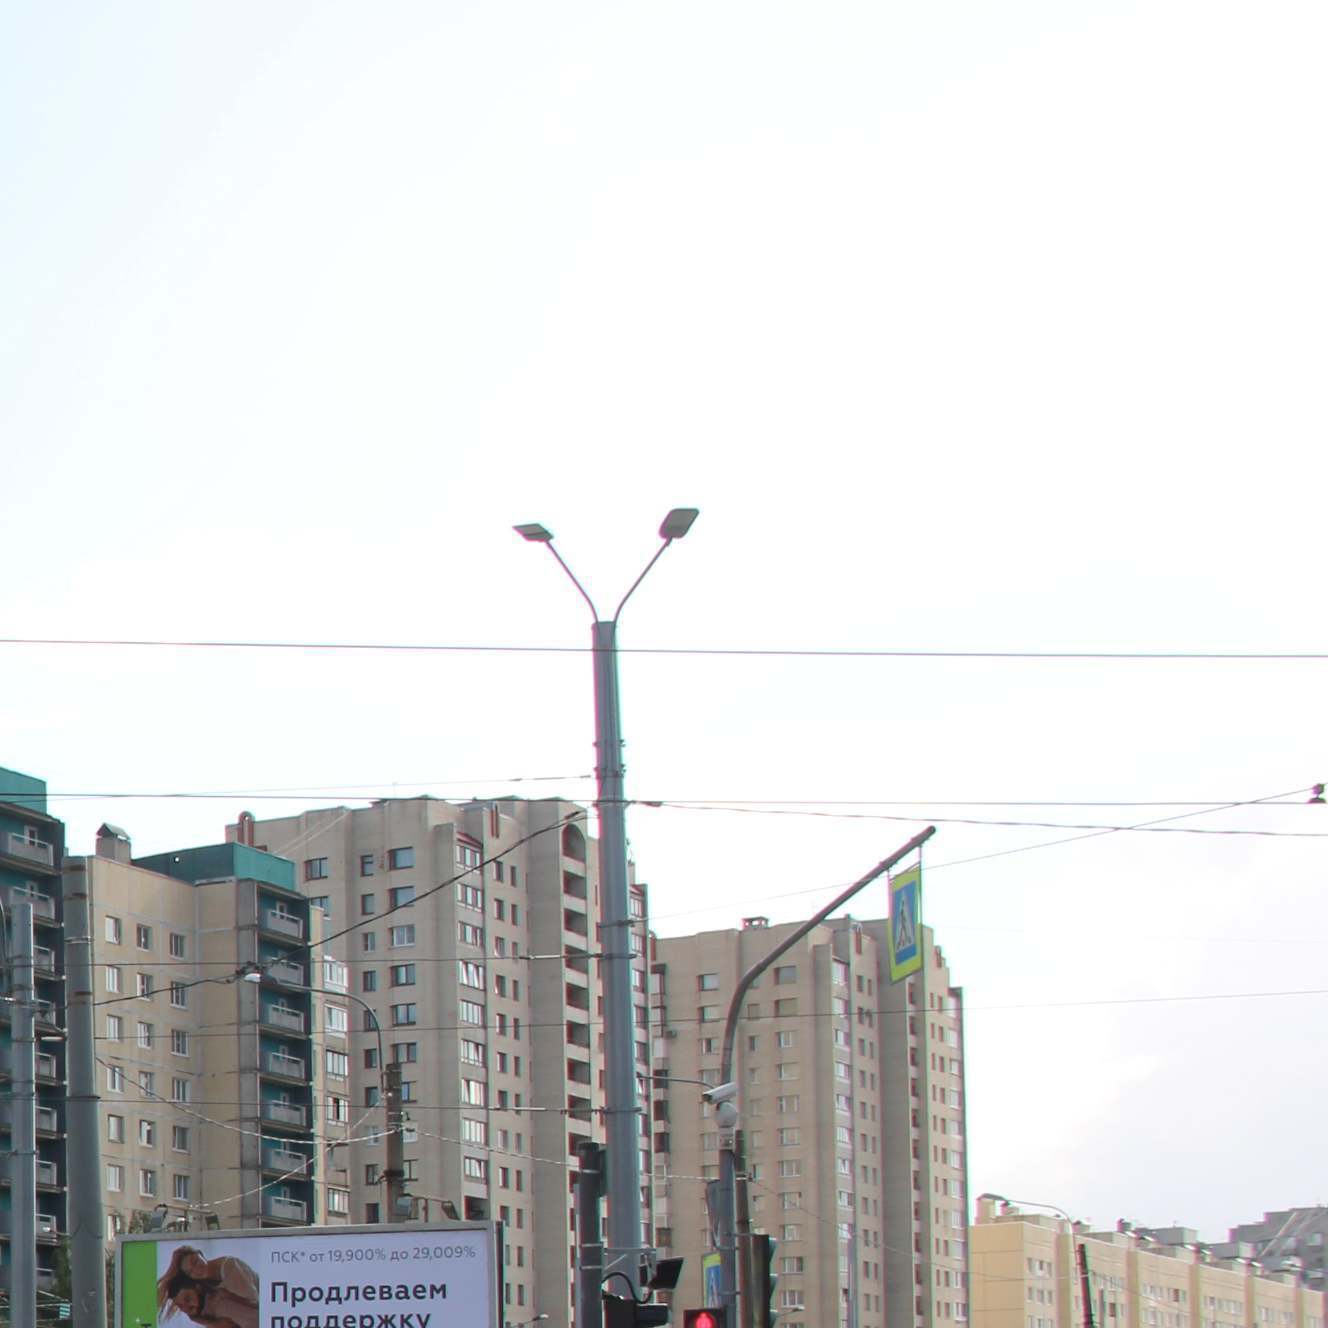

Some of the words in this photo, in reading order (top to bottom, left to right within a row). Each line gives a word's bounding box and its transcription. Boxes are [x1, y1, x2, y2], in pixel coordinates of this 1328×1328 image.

[309, 1253, 325, 1263] от
[328, 1248, 386, 1262] 19,900%
[390, 1250, 408, 1262] до
[412, 1246, 476, 1261] 29,009%
[271, 1282, 447, 1307] Продлеваем
